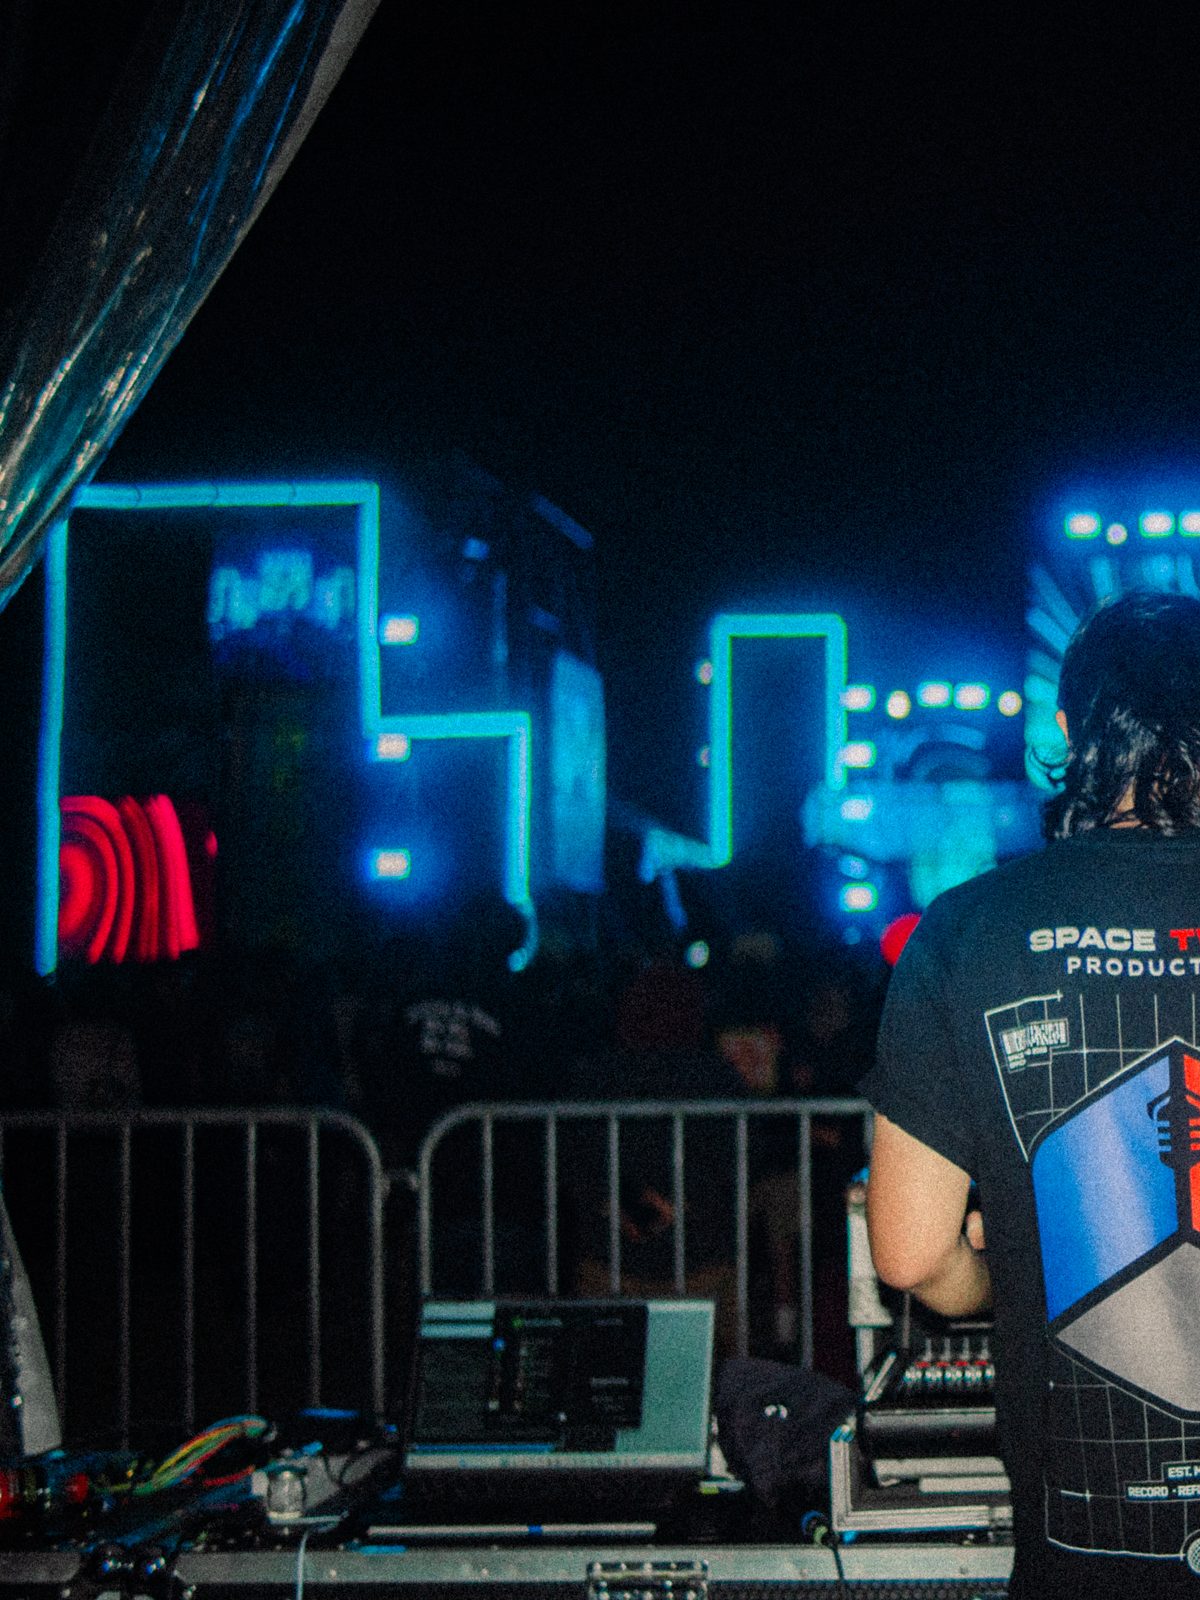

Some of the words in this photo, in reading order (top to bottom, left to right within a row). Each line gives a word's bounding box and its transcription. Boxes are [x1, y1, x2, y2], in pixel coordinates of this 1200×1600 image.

[1028, 926, 1156, 952] SPACE
[1167, 1465, 1192, 1478] EST.
[1127, 1486, 1169, 1498] RECORD
